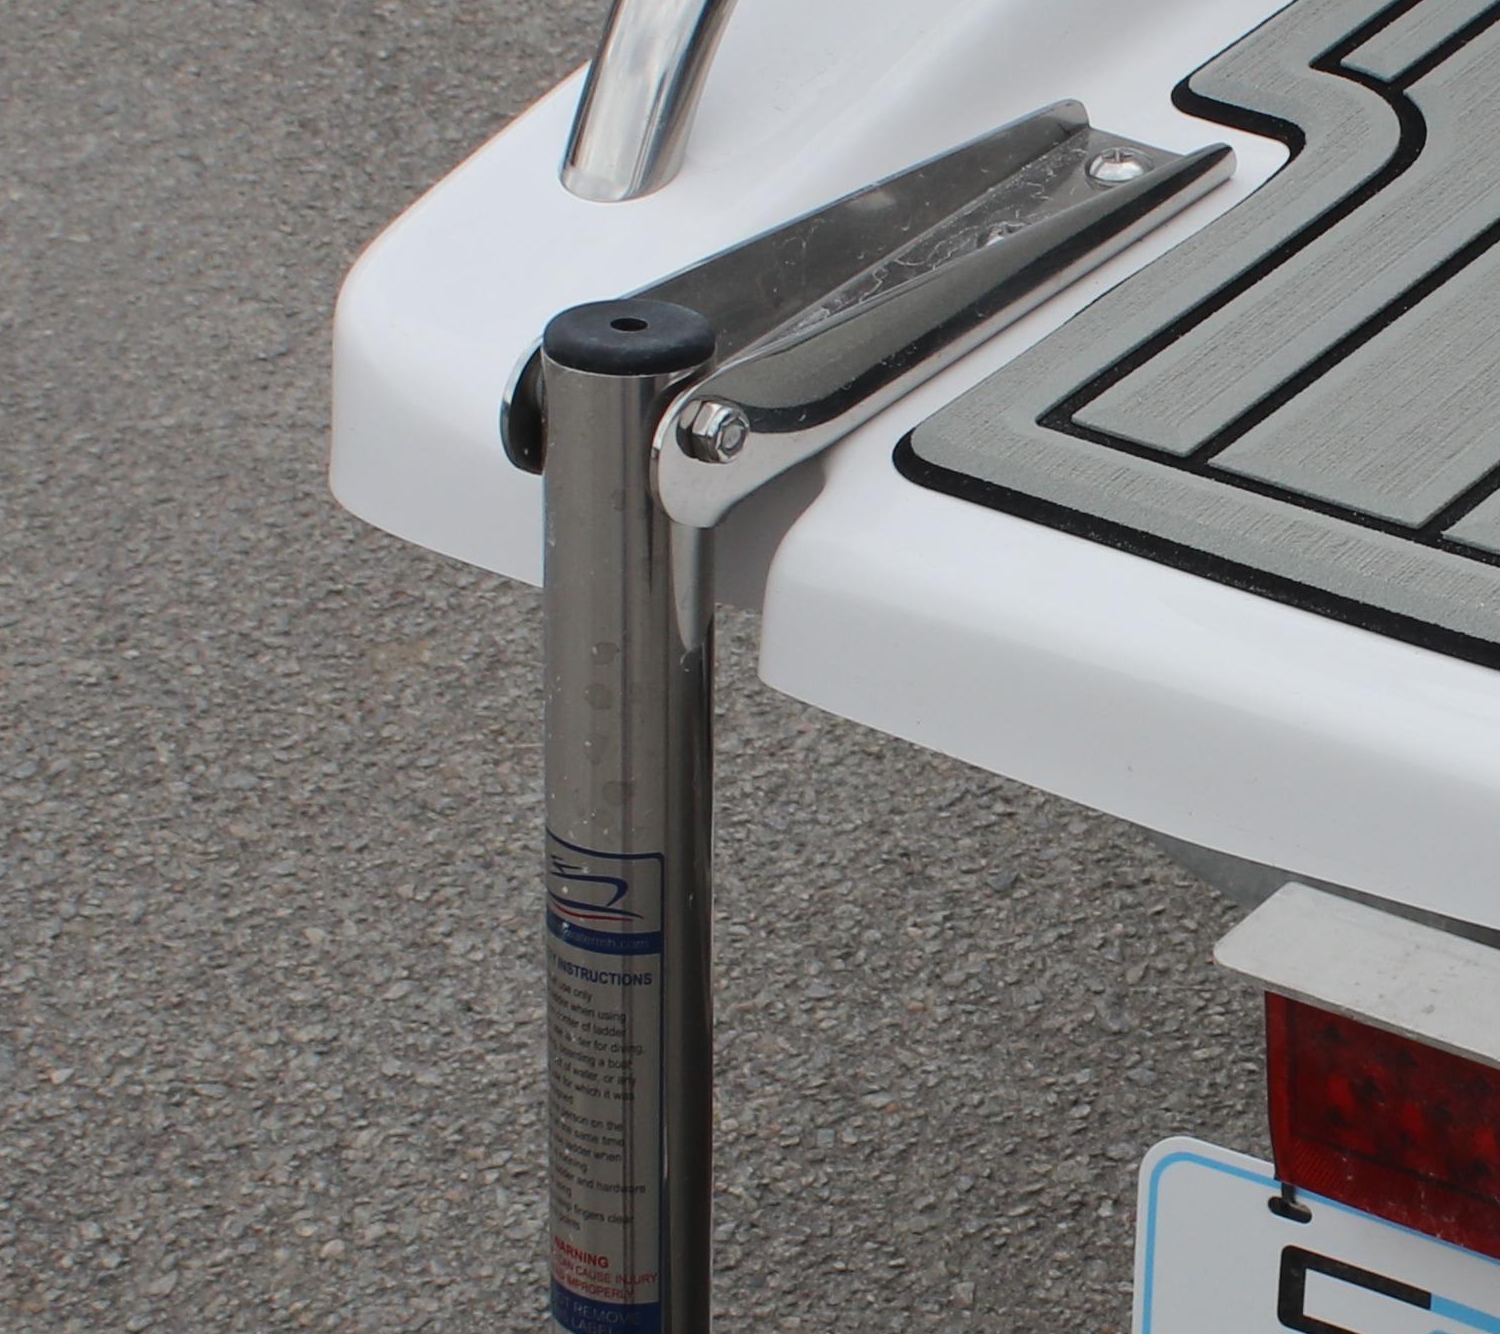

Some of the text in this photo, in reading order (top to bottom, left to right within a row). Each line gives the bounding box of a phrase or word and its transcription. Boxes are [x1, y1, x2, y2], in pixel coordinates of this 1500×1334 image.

[557, 955, 653, 986] INSTRUCTIONS
[598, 1008, 627, 1024] using
[593, 1037, 608, 1052] for
[596, 1181, 646, 1194] hardware
[553, 1235, 609, 1269] WARNING
[575, 1265, 611, 1284] CAUSE
[615, 1272, 658, 1286] INJURY
